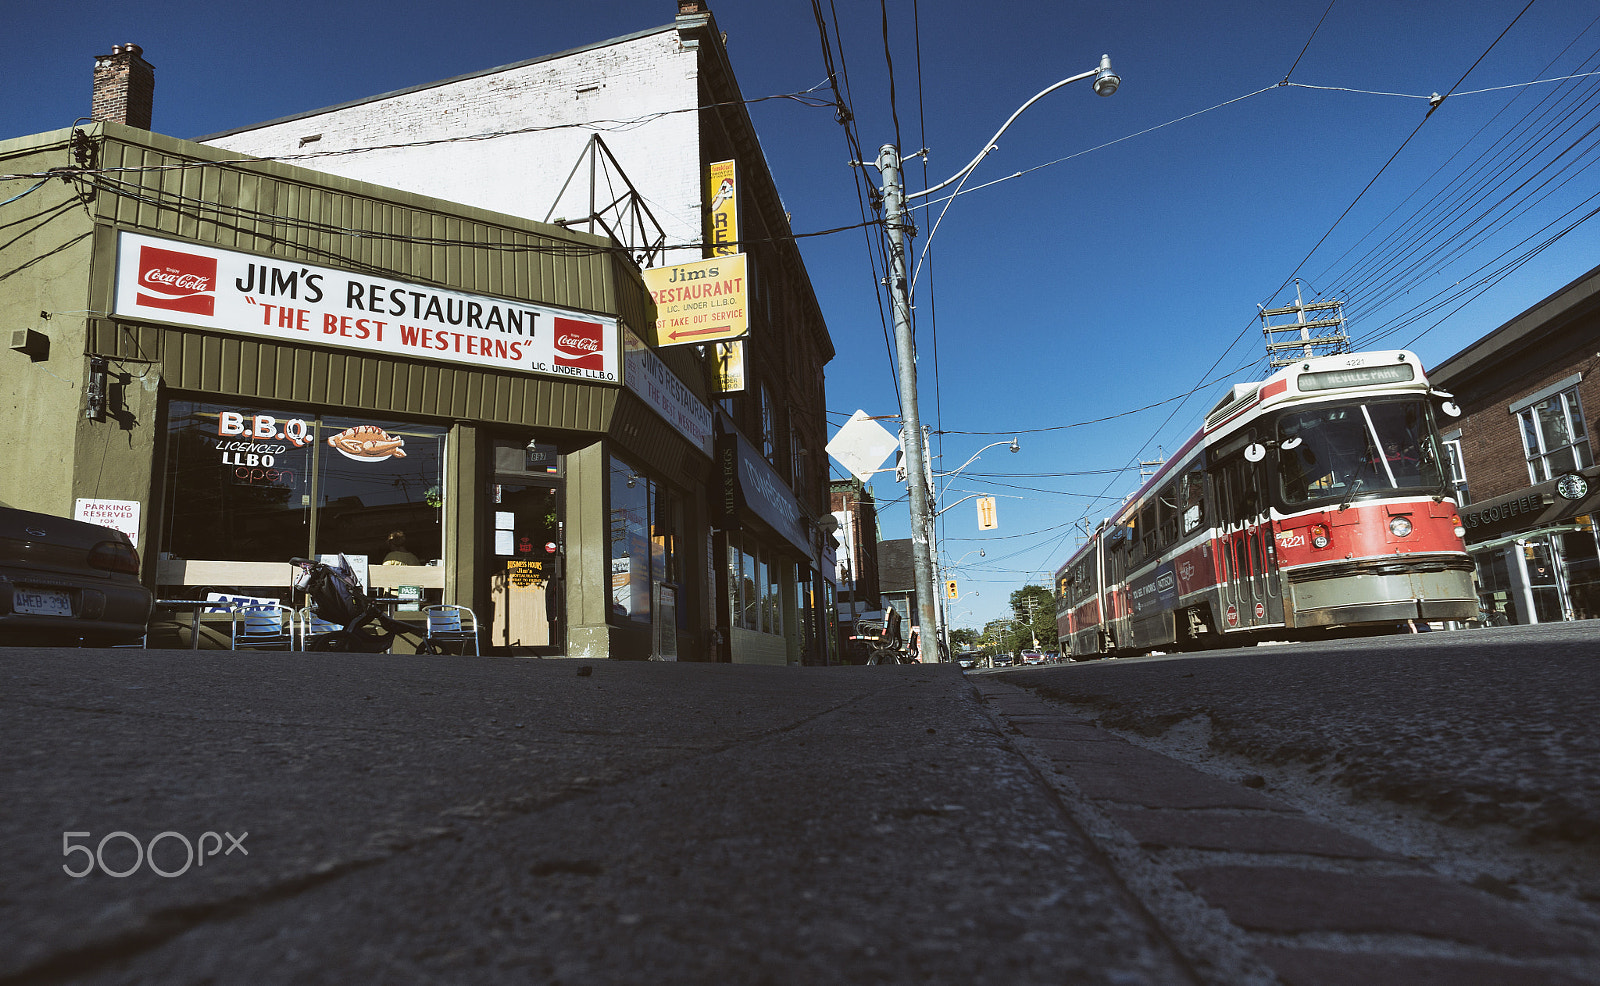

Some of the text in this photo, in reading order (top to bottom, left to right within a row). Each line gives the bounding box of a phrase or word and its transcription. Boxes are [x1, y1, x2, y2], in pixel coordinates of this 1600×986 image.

[144, 267, 210, 292] Coca-Cola
[669, 267, 720, 283] Jim's
[236, 263, 541, 337] JIM'S RESTAURANT
[650, 277, 742, 306] RESTAURANT
[667, 297, 737, 314] LIC. UNDER L.L.B.O.
[670, 316, 689, 327] TAKE
[693, 314, 708, 324] OUT
[712, 308, 743, 321] SERVICE
[323, 312, 388, 342] BEST
[400, 324, 533, 361] WESTERNS"
[557, 334, 600, 352] Coca-Cola
[531, 361, 549, 372] LIC.
[552, 364, 582, 377] UNDER
[585, 369, 616, 381] L.L.B.O.
[1346, 358, 1365, 367] 4221
[1327, 372, 1370, 384] NEVILLE
[1370, 368, 1399, 380] PARK
[662, 394, 676, 419] BEST
[666, 370, 711, 429] RESTAURANT
[218, 411, 314, 447] B.B.Q.
[216, 440, 286, 454] LICENCED
[222, 452, 275, 467] LLBO
[724, 448, 733, 475] EGGS
[235, 467, 294, 484] open
[85, 503, 132, 512] PARKING
[726, 487, 734, 515] MILK
[1481, 494, 1540, 524] COFFEE
[83, 510, 133, 519] RESERVED
[1280, 535, 1305, 548] 4221
[208, 595, 276, 613] ATM
